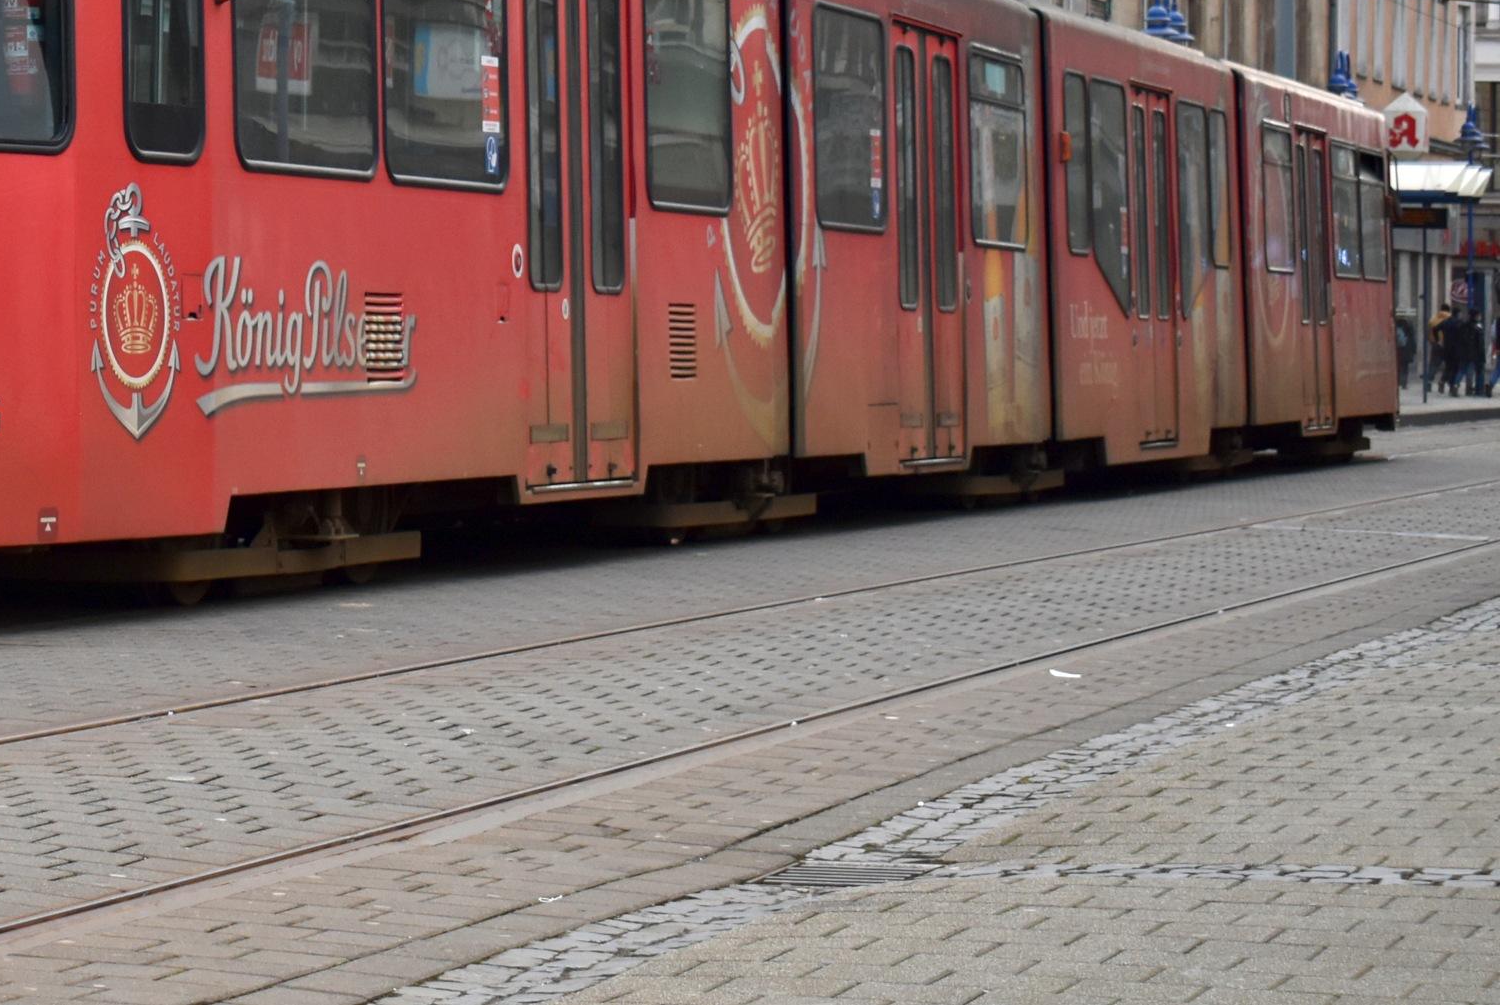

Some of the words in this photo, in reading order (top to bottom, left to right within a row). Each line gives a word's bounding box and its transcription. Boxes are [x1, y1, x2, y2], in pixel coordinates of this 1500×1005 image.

[90, 250, 106, 329] PURUM
[153, 232, 180, 331] LAUDATUR
[194, 256, 303, 394] König
[302, 260, 416, 370] Pilser
